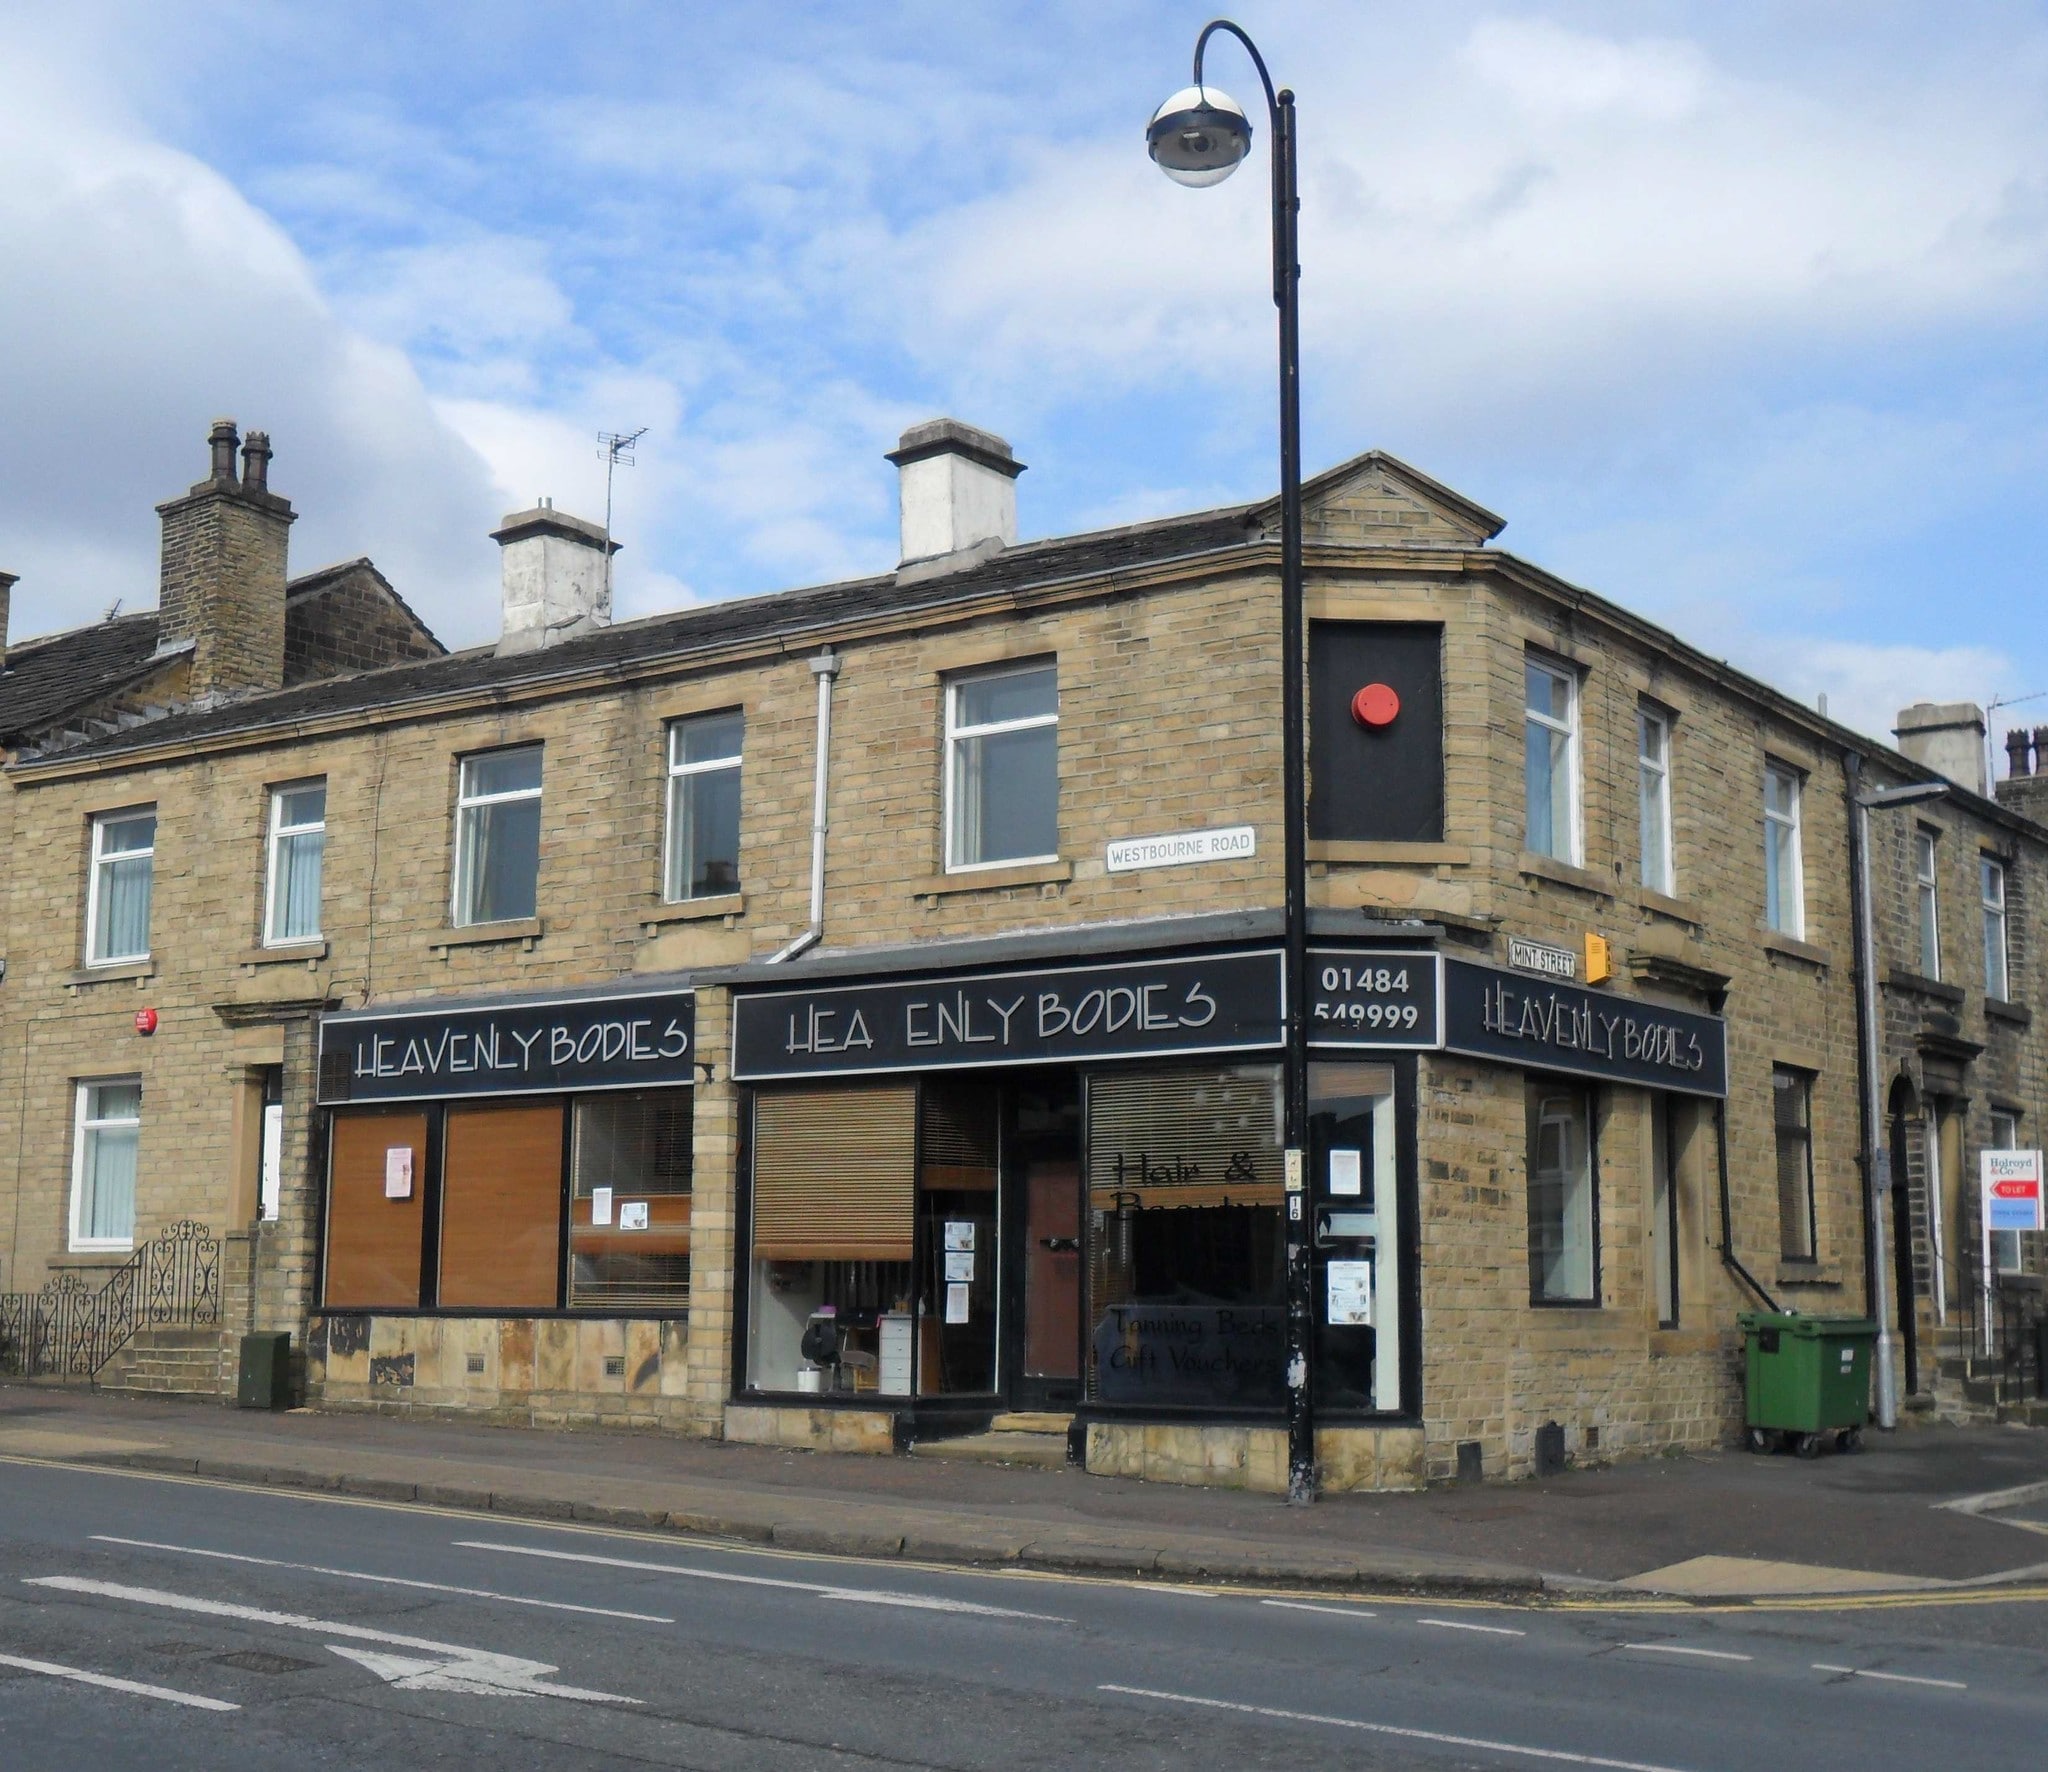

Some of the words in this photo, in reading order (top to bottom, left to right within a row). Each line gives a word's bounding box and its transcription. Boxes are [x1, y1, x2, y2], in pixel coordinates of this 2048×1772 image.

[1111, 839, 1203, 864] WESTBOURNE
[1211, 834, 1250, 853] ROAD
[1514, 945, 1537, 967] MINT
[1540, 951, 1572, 976] STREET
[1321, 967, 1409, 993] 01484
[1038, 982, 1217, 1038] BODIES
[1483, 979, 1620, 1060] HEAVENLY
[1624, 1017, 1703, 1072] BODIES
[354, 1022, 543, 1078] HEAVENLY
[551, 1019, 688, 1066] BODIES
[1112, 1153, 1200, 1186] Hair
[1224, 1151, 1258, 1183] &
[1990, 1157, 2033, 1169] Holroyd
[2000, 1185, 2011, 1194] TO
[2012, 1185, 2026, 1194] LET
[1110, 1191, 1260, 1221] Beat
[1110, 1308, 1202, 1344] Tanning
